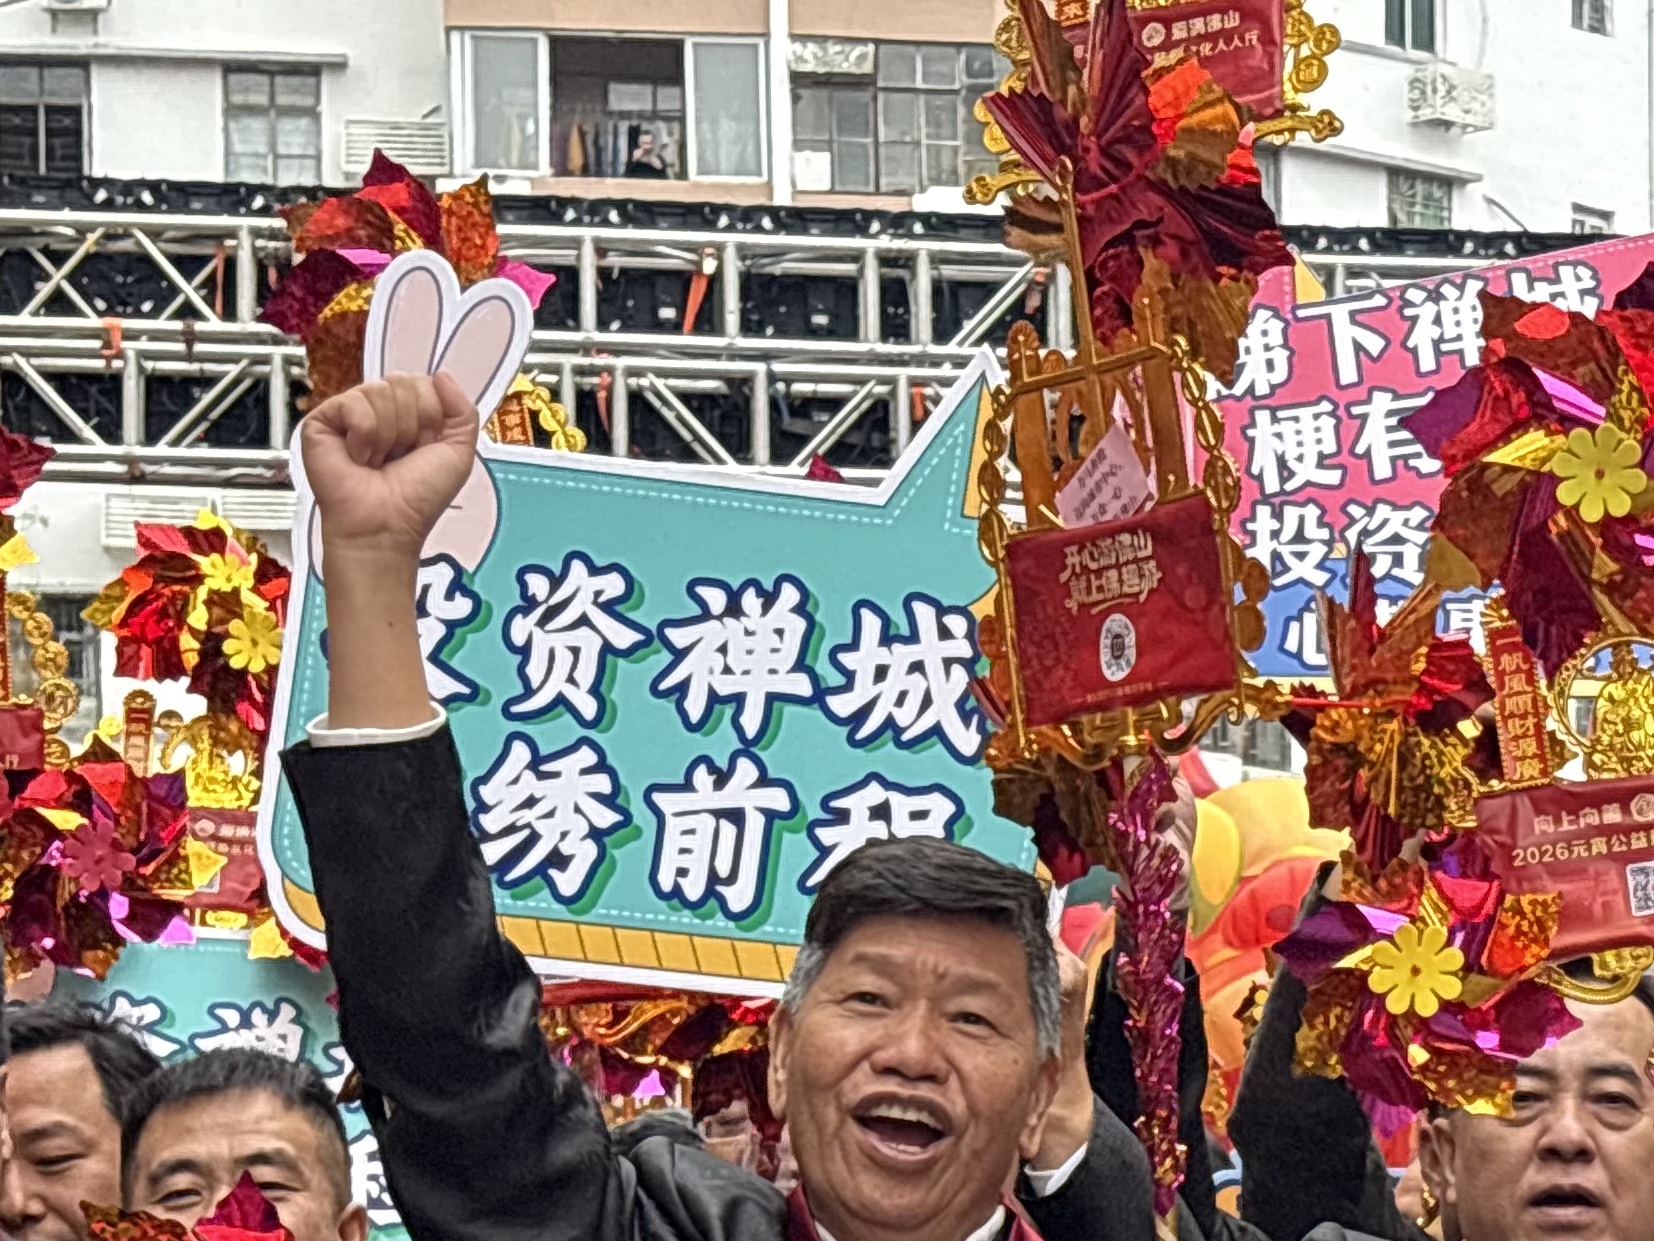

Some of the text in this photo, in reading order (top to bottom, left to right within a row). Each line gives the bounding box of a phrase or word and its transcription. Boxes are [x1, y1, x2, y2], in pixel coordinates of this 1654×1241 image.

[1247, 391, 1444, 495] 梗有
[1247, 502, 1431, 588] 投资
[1533, 801, 1622, 835] 向上向善
